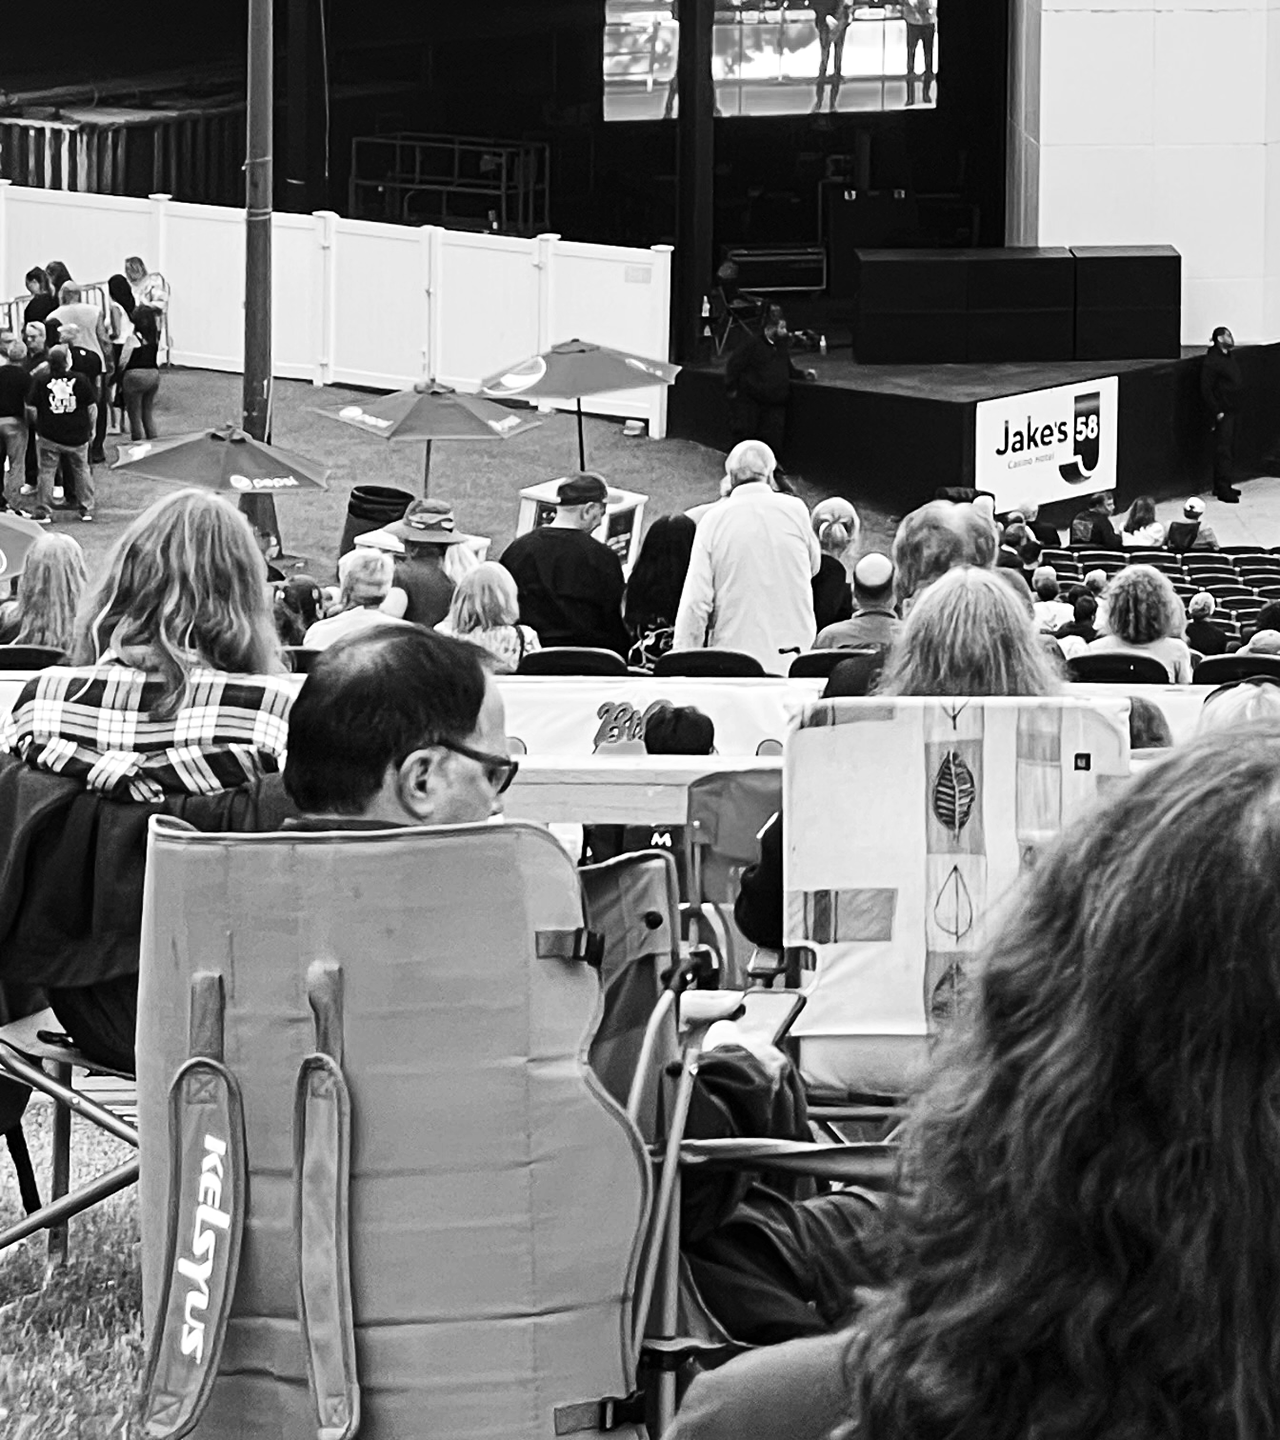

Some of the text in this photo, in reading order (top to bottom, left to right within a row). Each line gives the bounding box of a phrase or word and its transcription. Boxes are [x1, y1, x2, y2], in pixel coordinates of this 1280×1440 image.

[995, 414, 1099, 456] Jake's 58
[178, 1134, 231, 1364] KELSYUS
